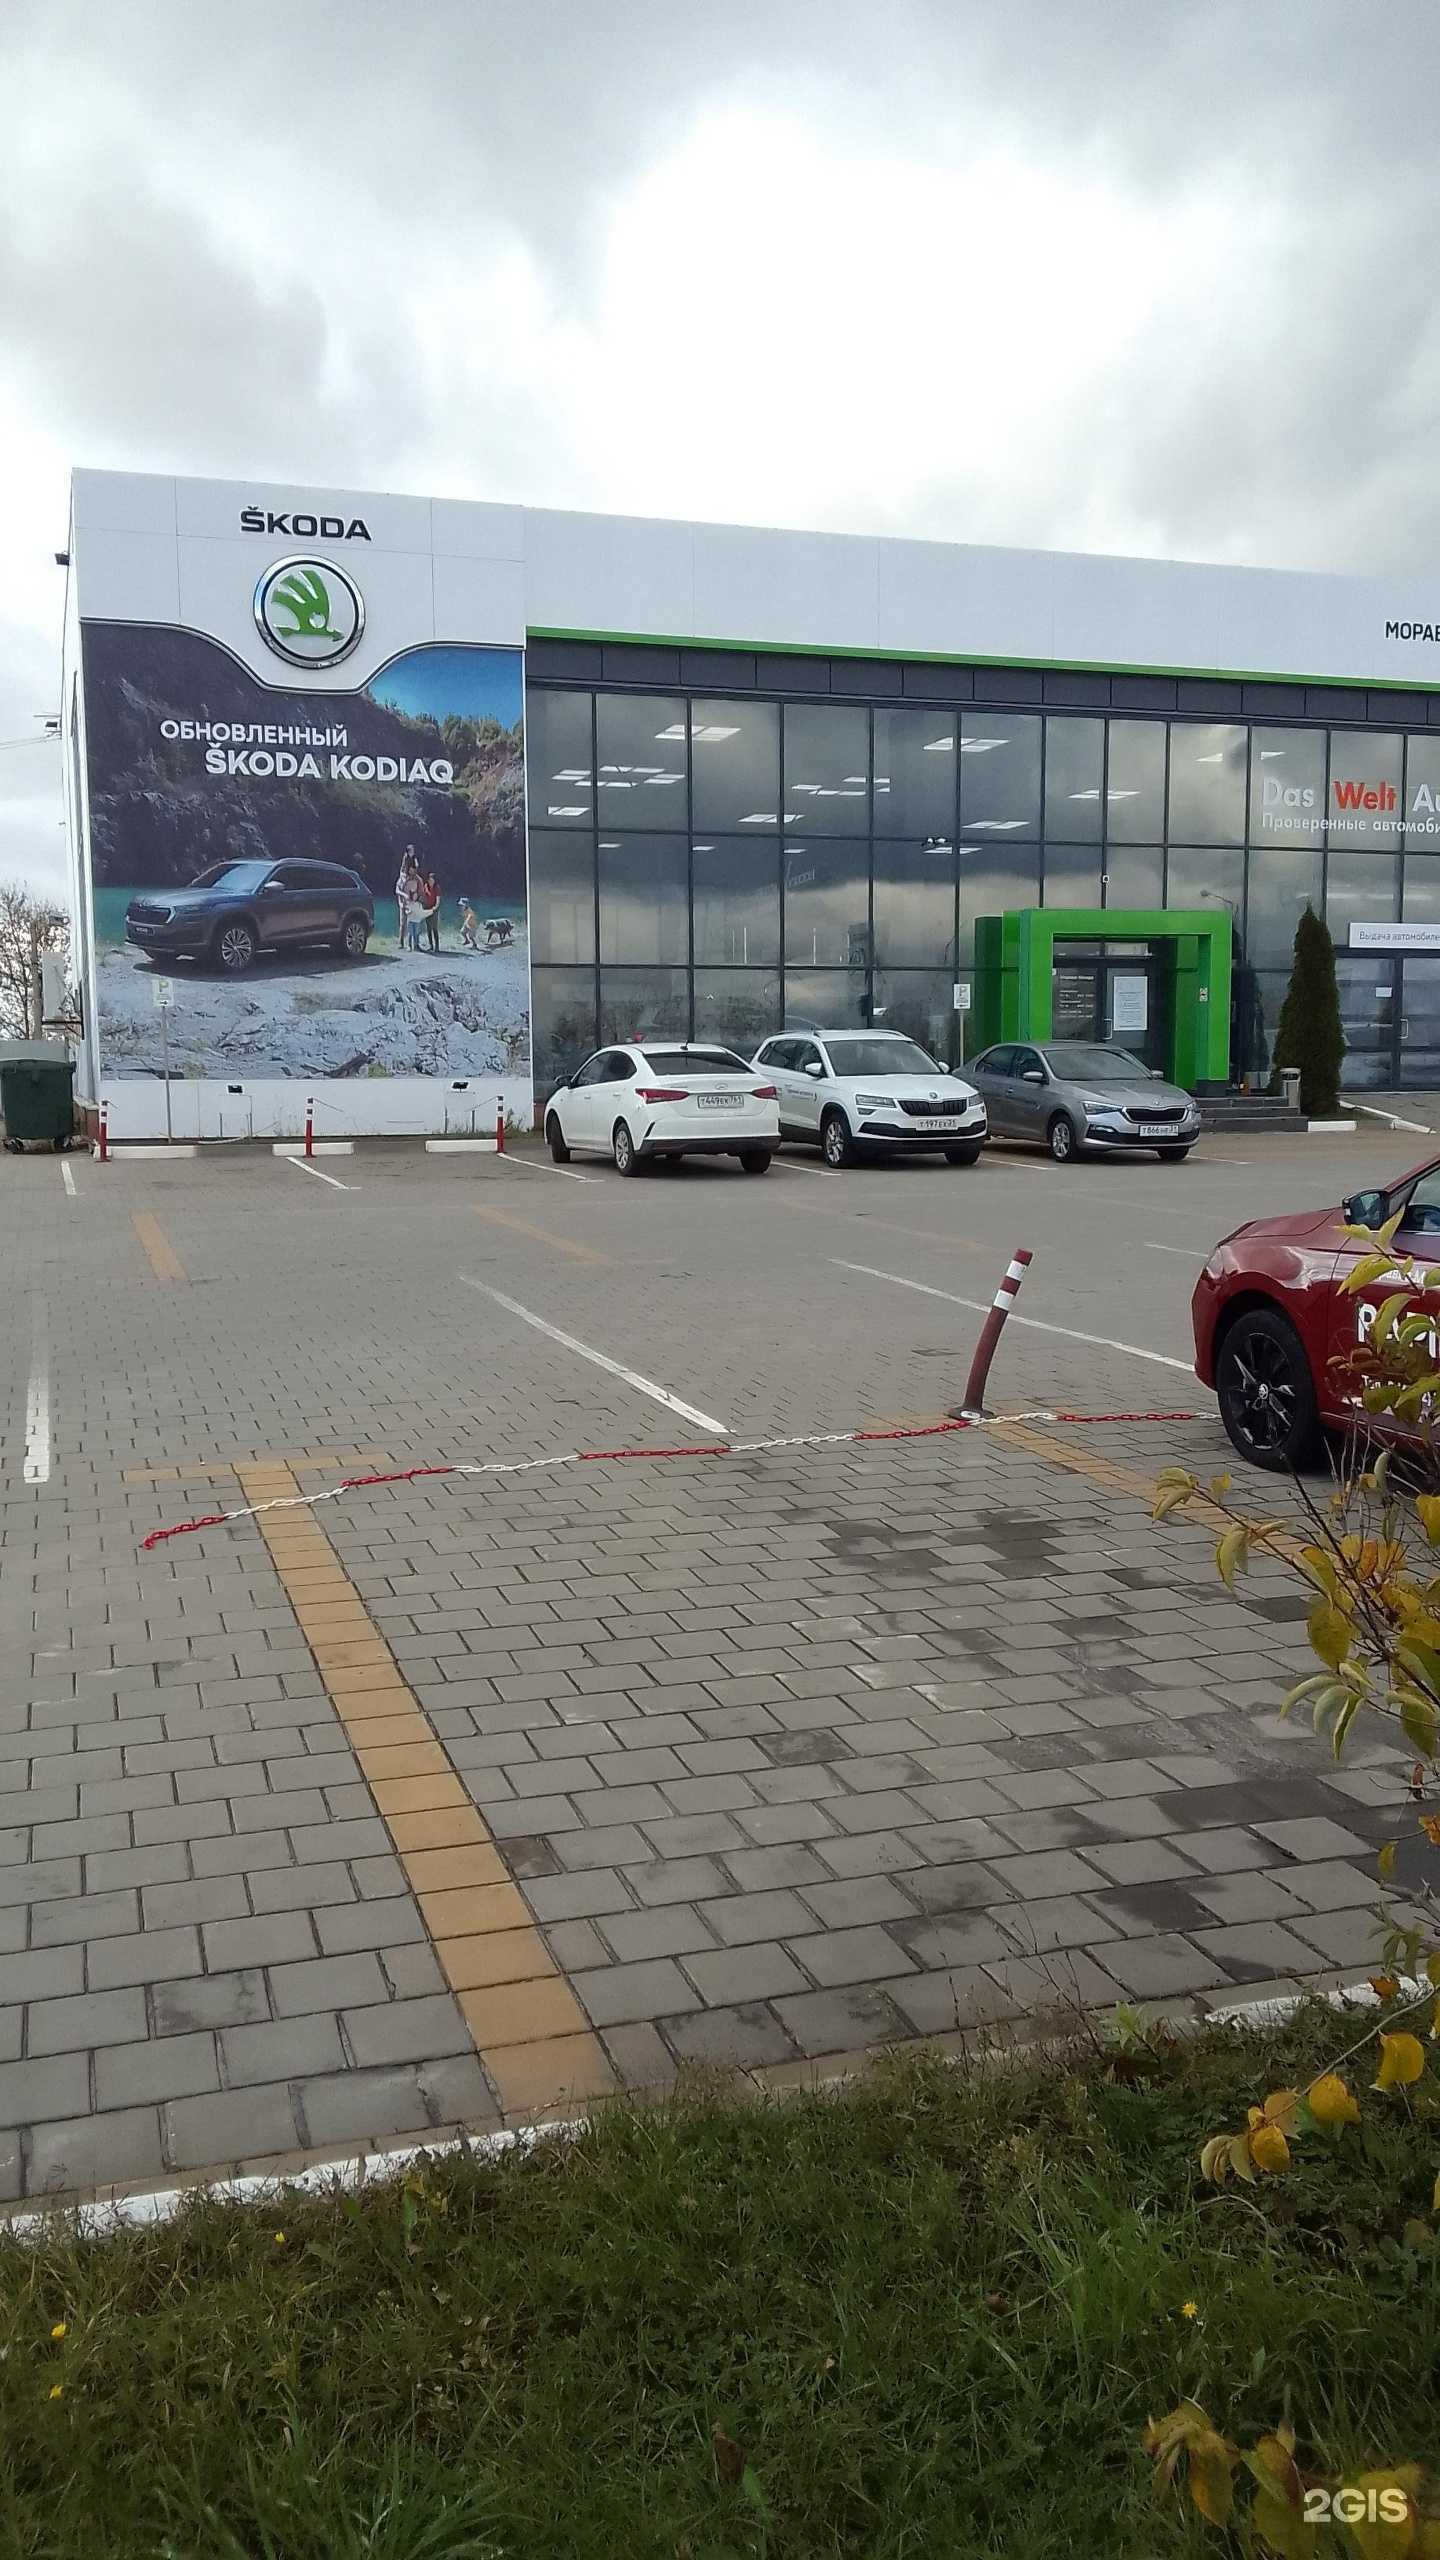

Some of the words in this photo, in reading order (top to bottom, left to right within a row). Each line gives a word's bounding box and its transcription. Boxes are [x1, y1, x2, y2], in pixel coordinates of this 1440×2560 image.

[240, 505, 372, 541] ŠKODA
[160, 719, 348, 748] ОБНОВЛЕННЫЙ
[205, 742, 322, 779] ŠKODA
[330, 754, 454, 784] KODIAQ
[1262, 776, 1315, 808] Das
[1333, 780, 1397, 811] Welt
[1262, 812, 1367, 832] Проверенные
[1359, 930, 1391, 941] Выдача
